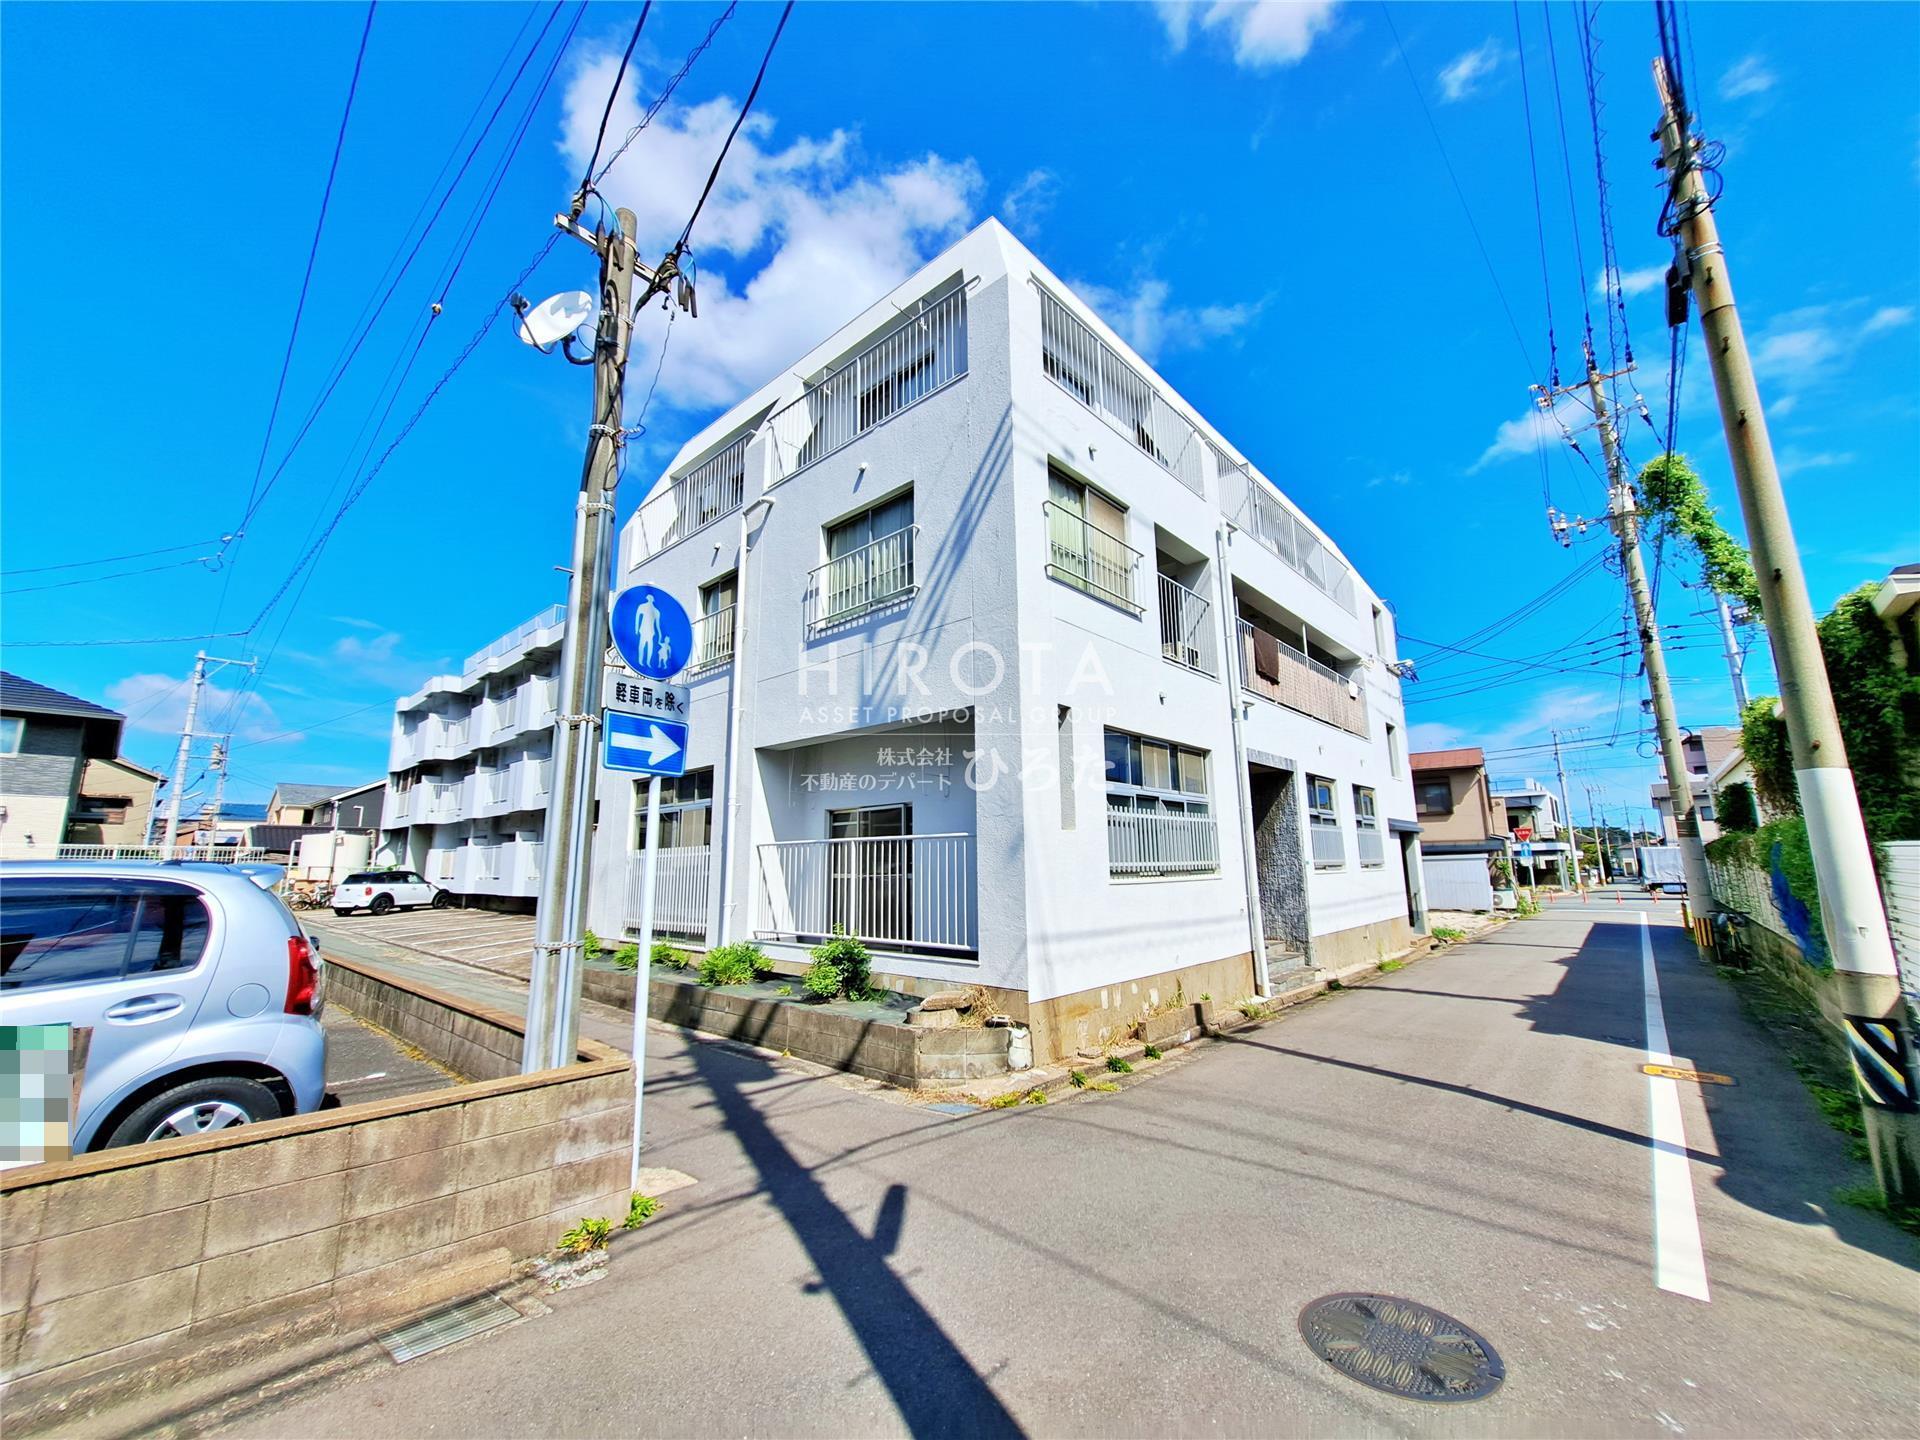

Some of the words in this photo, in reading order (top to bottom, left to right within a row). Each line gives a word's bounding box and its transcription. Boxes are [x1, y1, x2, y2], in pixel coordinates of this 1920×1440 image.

[616, 682, 684, 714] 軽車両を除く
